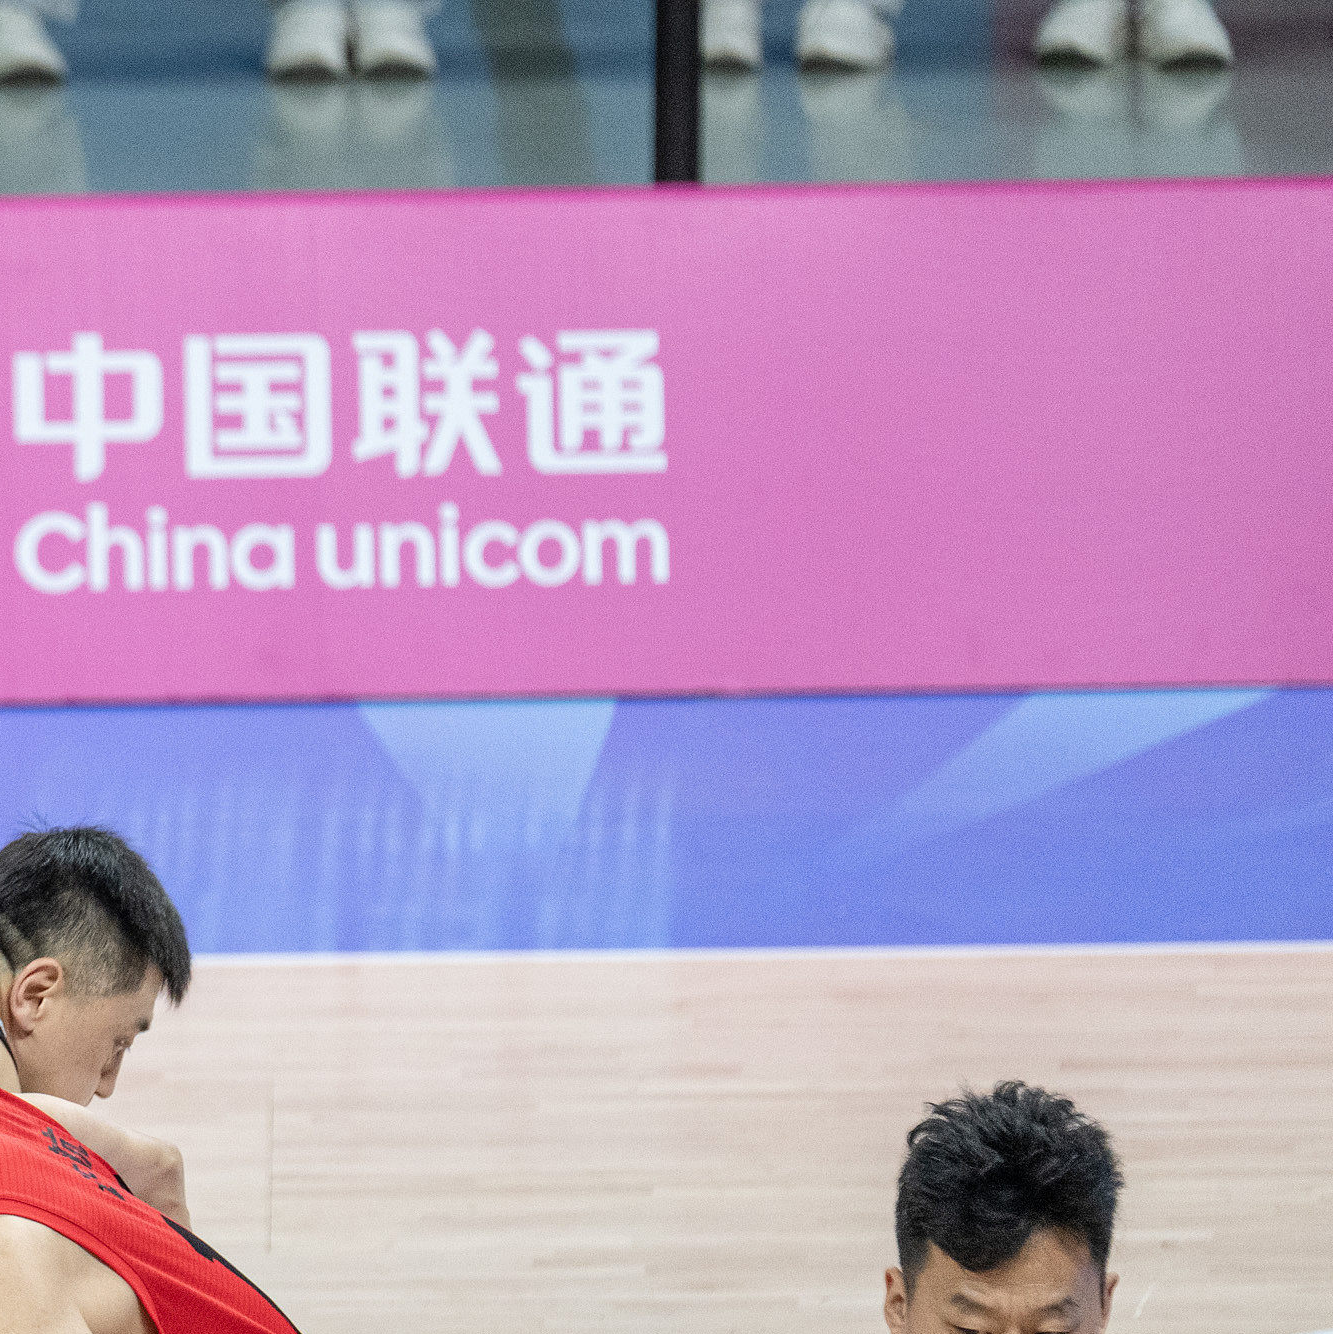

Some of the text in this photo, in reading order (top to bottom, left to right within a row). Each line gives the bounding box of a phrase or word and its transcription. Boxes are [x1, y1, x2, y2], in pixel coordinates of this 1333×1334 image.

[12, 328, 669, 483] 中国联通
[14, 500, 671, 594] China unicom
